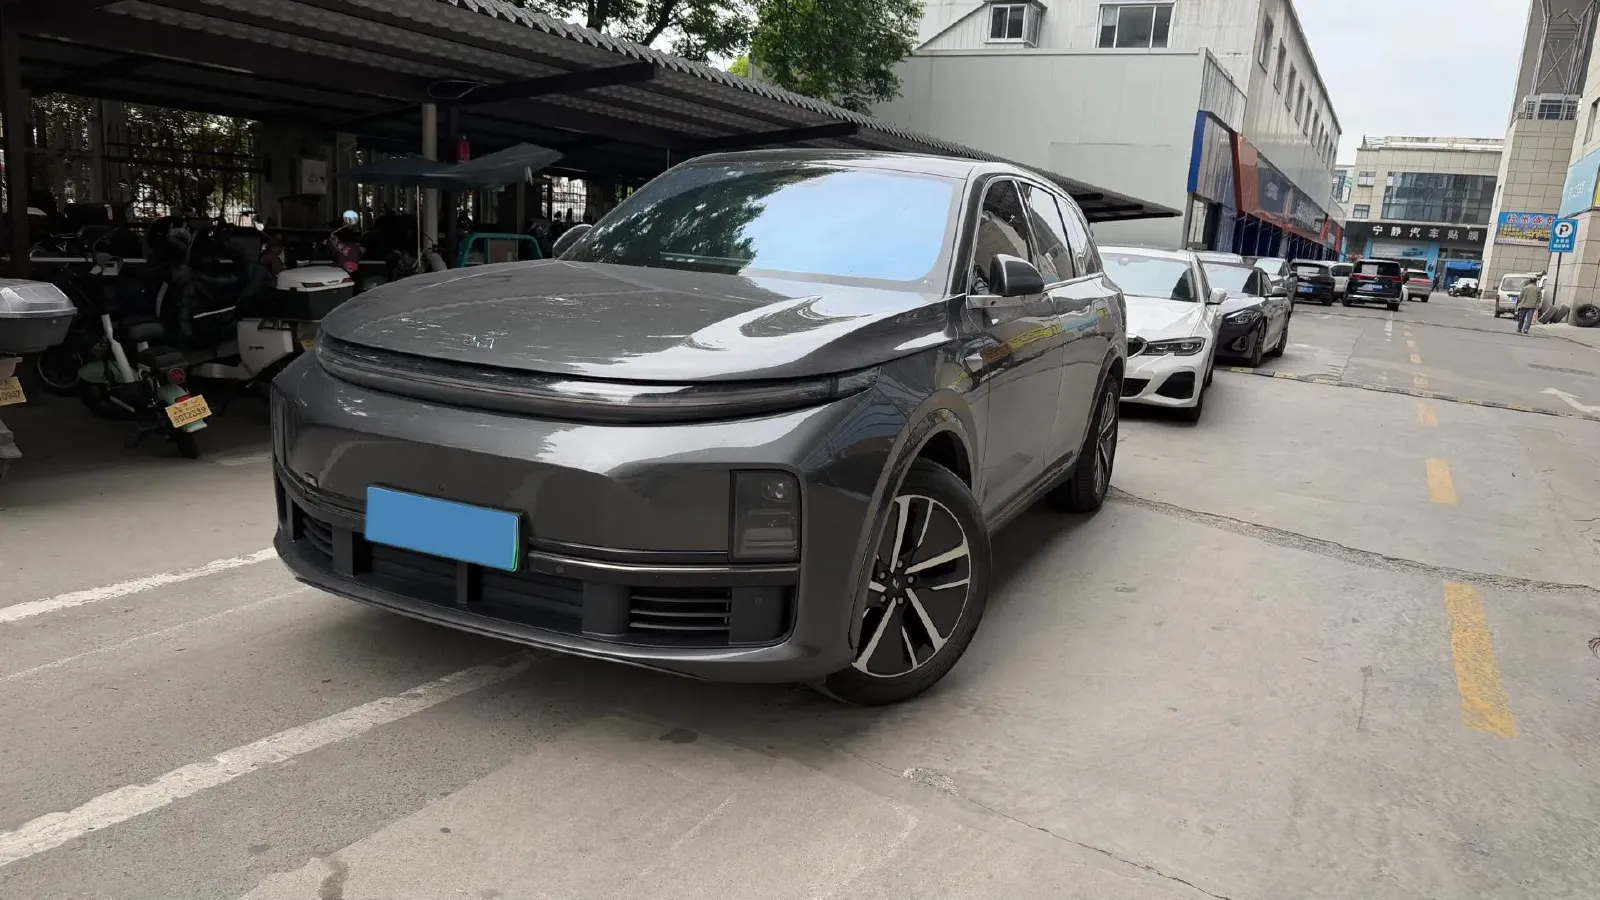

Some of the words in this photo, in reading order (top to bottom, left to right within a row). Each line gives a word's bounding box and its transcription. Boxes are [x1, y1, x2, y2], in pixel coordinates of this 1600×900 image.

[1372, 225, 1479, 241] 宁静汽车贴膜
